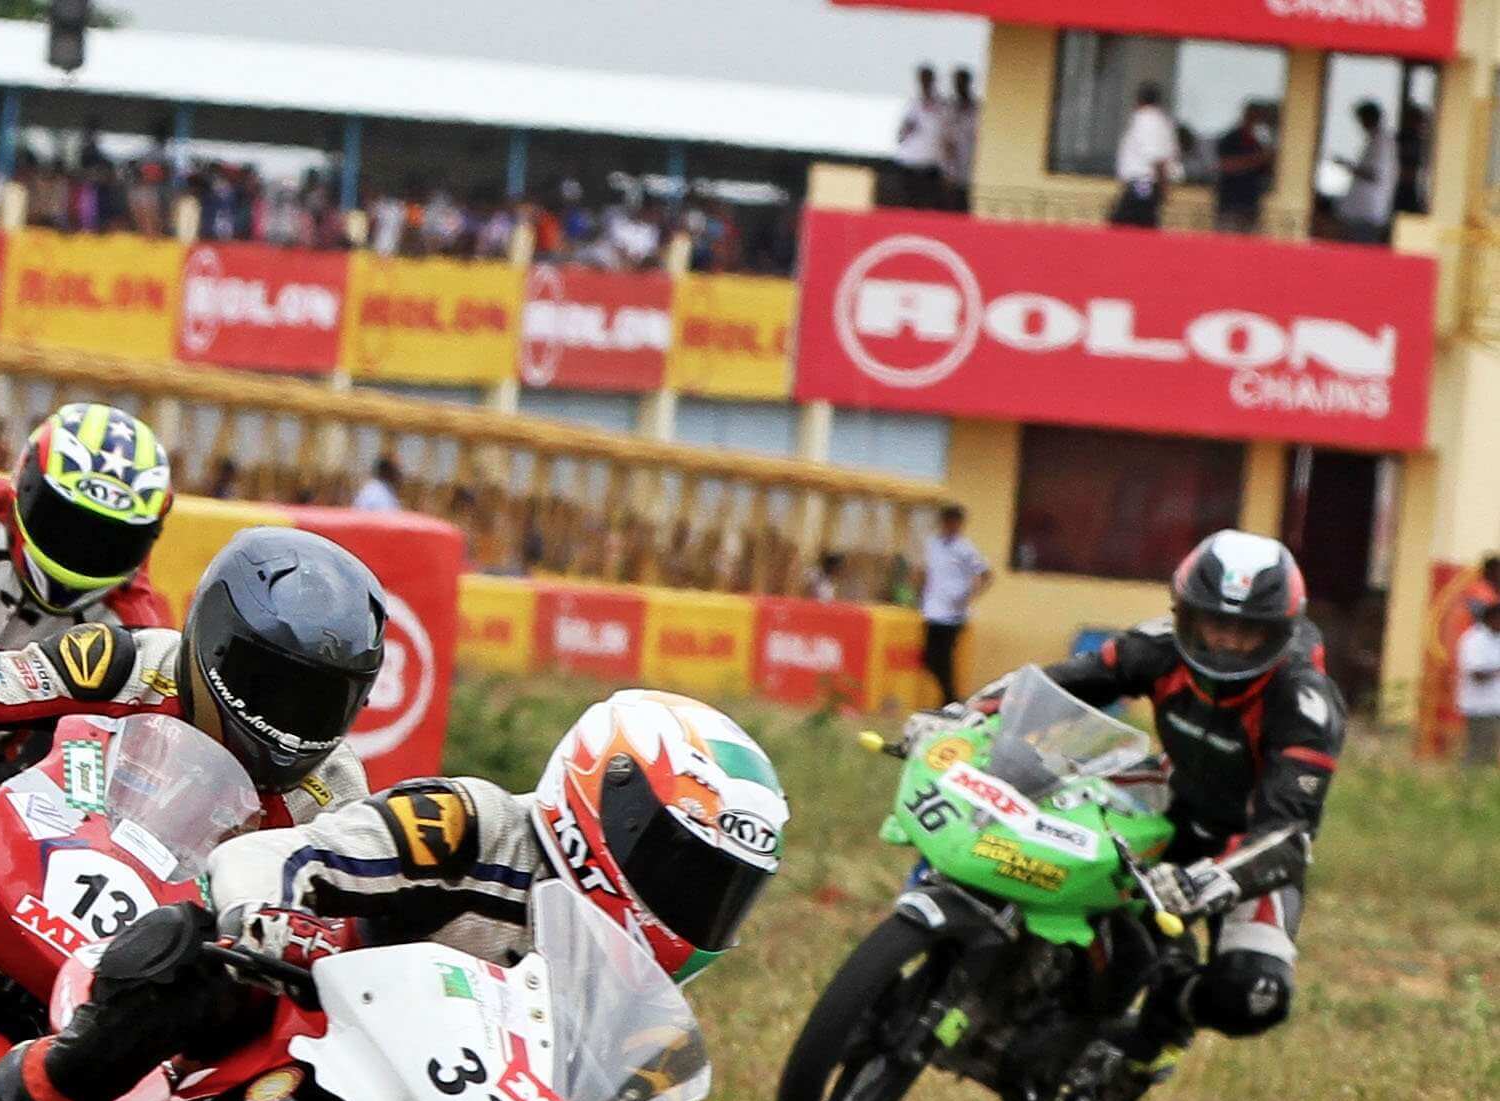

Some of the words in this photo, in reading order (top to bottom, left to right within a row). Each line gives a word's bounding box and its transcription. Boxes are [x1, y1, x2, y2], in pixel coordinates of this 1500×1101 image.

[852, 278, 1397, 377] ROLON
[1229, 369, 1391, 418] CHAINS
[720, 813, 777, 849] KYT
[71, 873, 137, 939] 13
